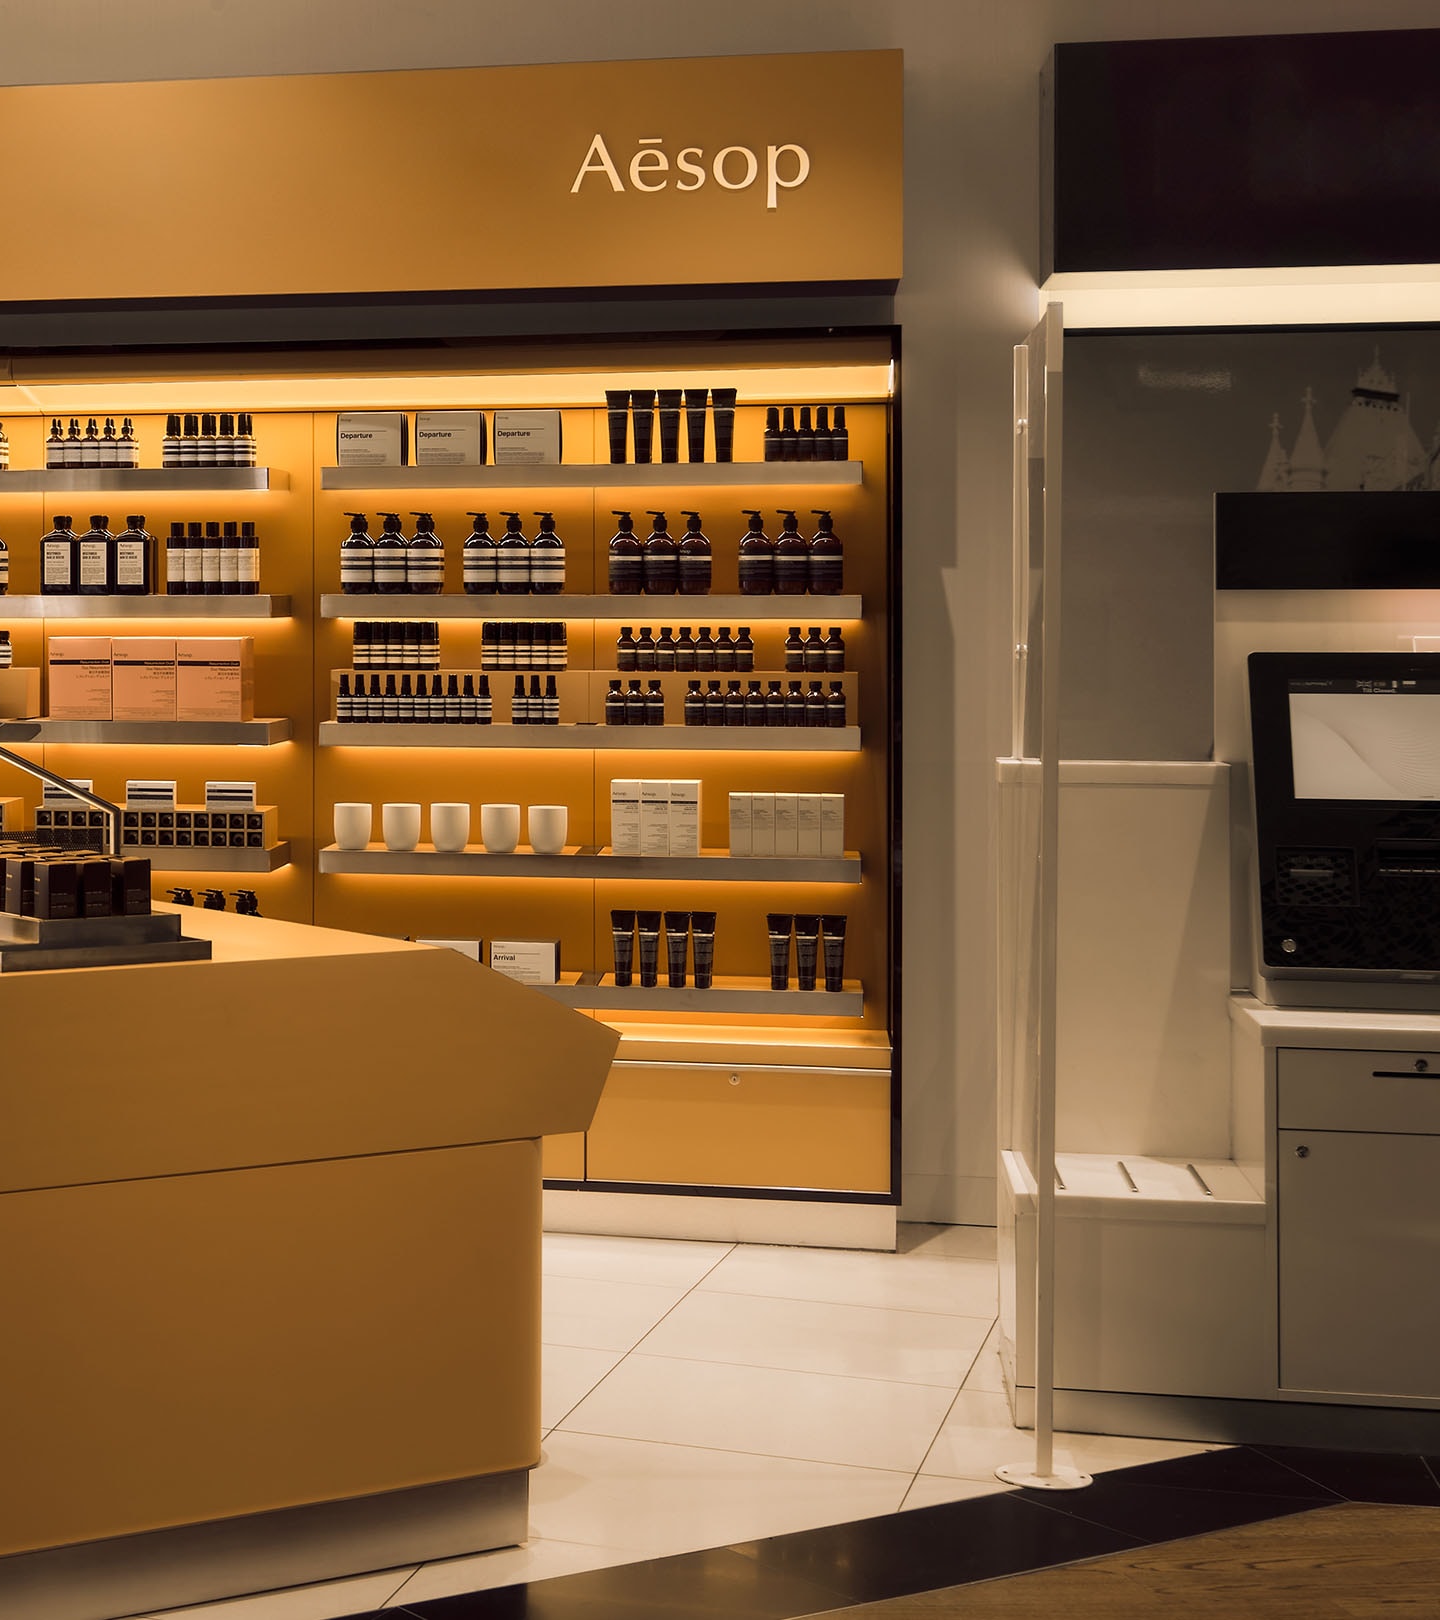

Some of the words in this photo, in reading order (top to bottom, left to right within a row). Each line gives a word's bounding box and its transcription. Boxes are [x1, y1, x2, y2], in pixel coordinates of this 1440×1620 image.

[570, 134, 810, 209] Aēsop
[340, 432, 373, 441] Departure
[419, 431, 452, 440] Departure
[497, 430, 531, 438] Departure
